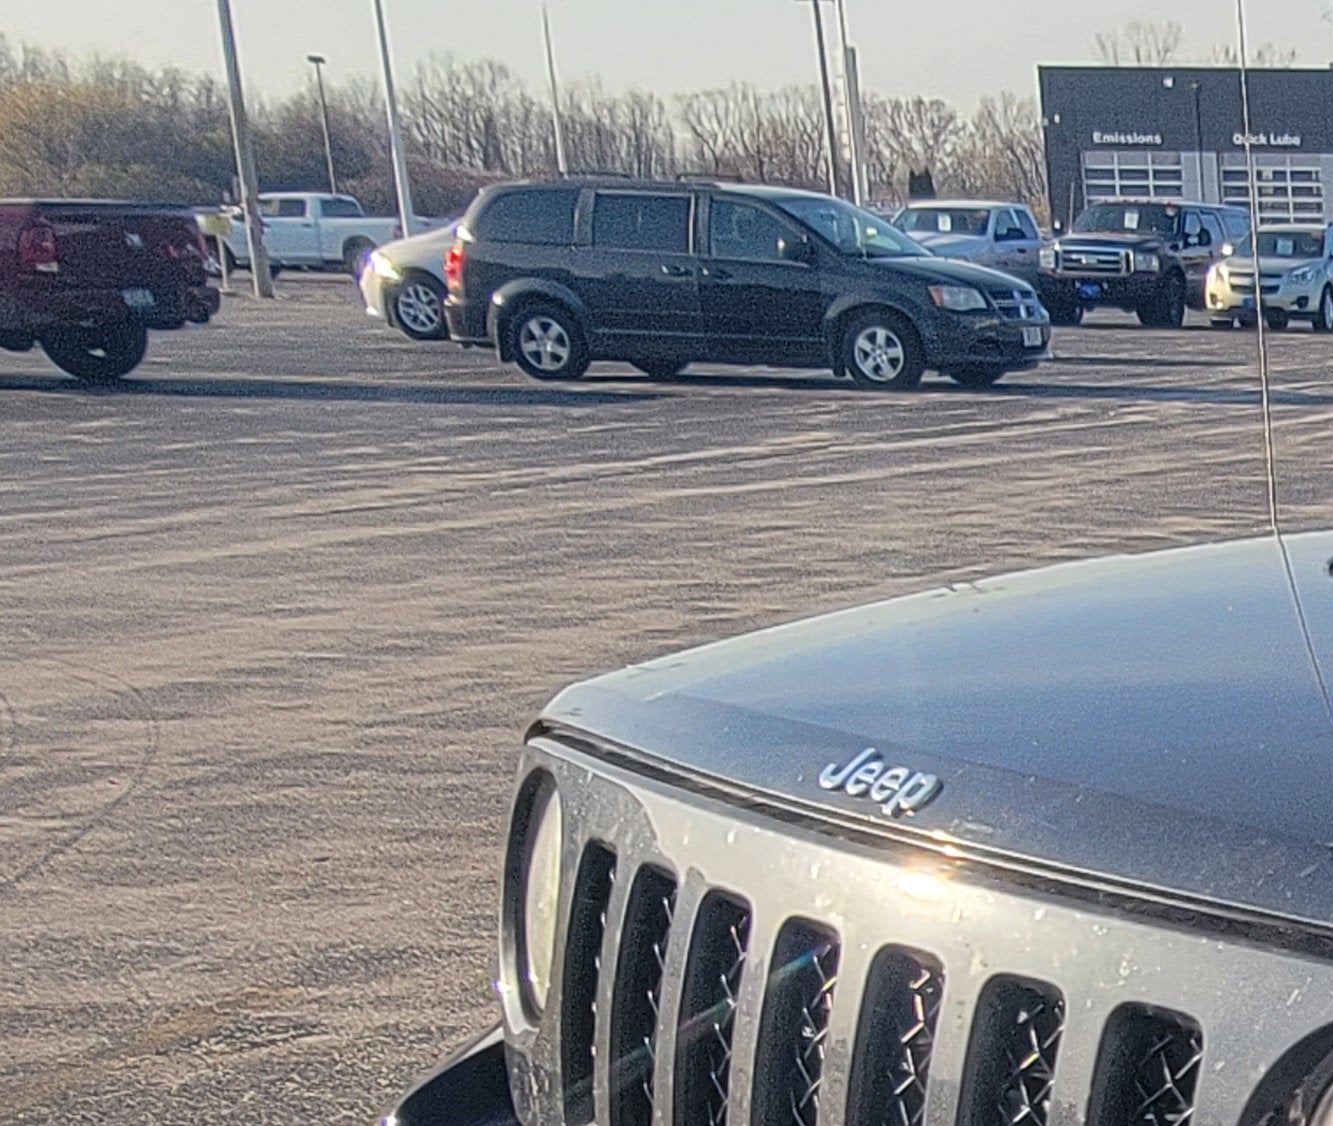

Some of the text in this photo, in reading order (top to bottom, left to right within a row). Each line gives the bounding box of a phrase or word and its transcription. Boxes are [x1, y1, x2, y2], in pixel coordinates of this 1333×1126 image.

[1092, 131, 1163, 145] Emissions
[1270, 132, 1301, 147] Lube
[818, 747, 940, 816] Jeep
